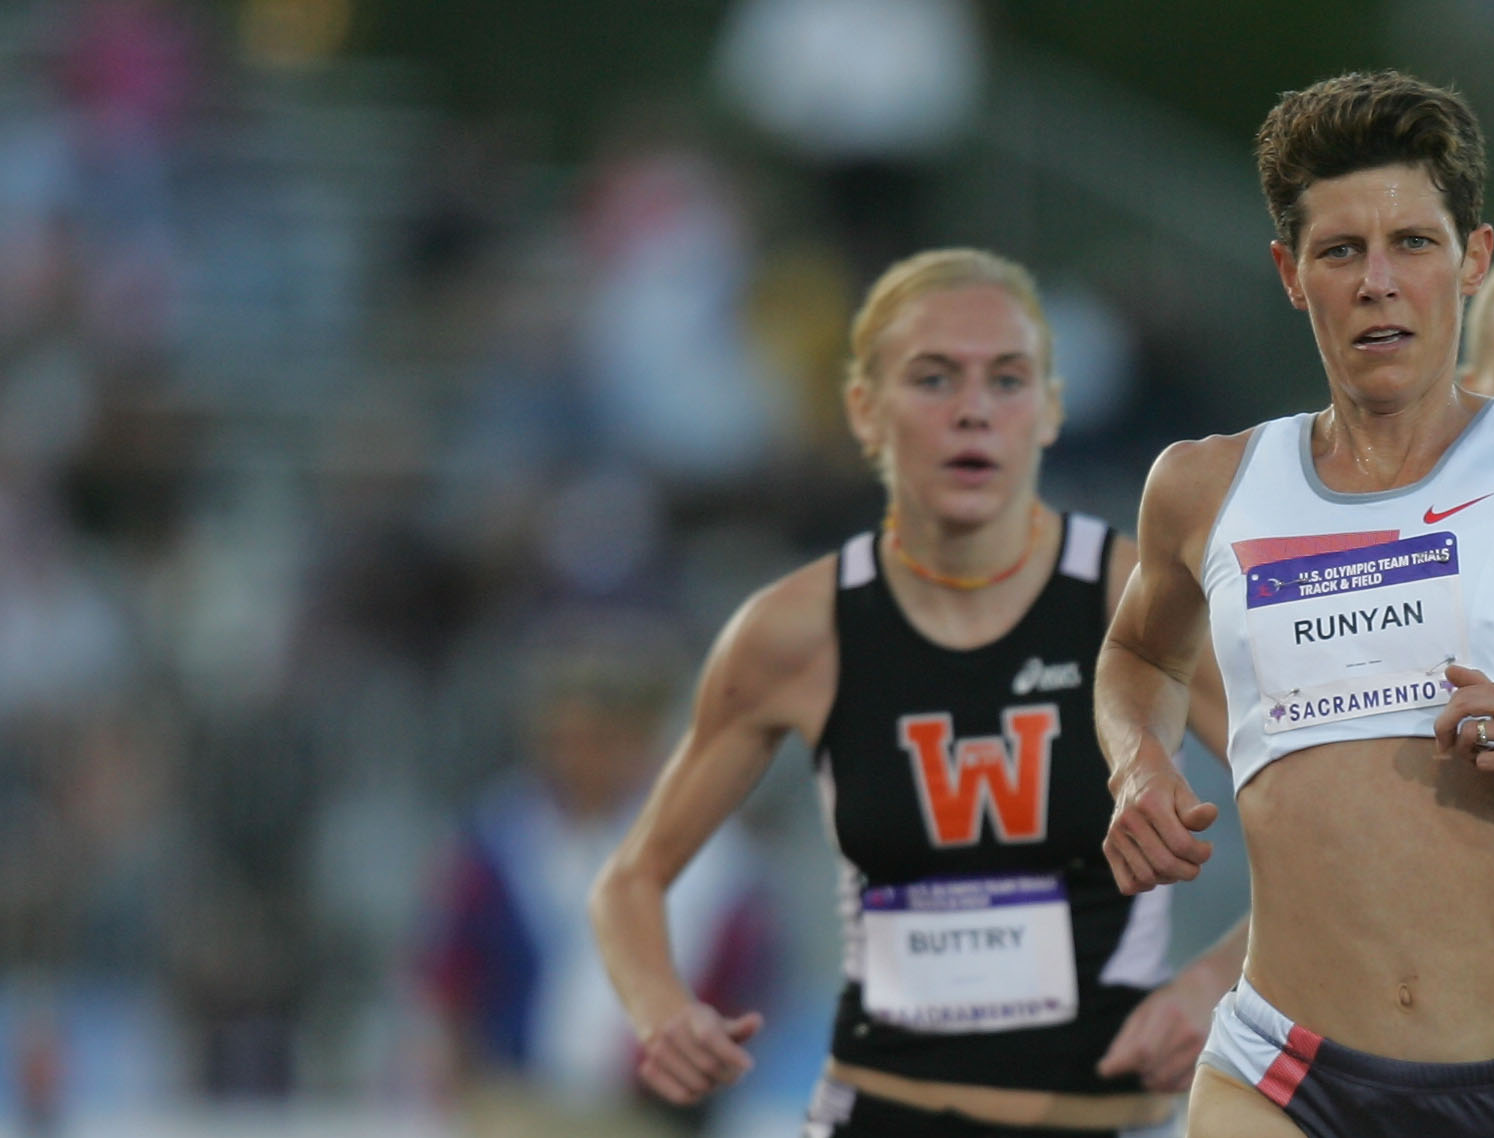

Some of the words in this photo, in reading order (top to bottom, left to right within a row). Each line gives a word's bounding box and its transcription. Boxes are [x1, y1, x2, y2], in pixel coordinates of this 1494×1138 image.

[1299, 570, 1323, 582] U.S.
[1324, 561, 1377, 580] OLYMPIC
[1377, 553, 1409, 571] TEAM
[1411, 548, 1450, 566] TRIALS
[1299, 581, 1338, 597] TRACK
[1339, 579, 1350, 590] &
[1351, 573, 1383, 588] FIELD
[1294, 600, 1424, 645] RUNYAN
[1289, 681, 1437, 722] SACRAMENTO
[898, 704, 1060, 848] W
[907, 924, 1026, 955] BUTTRY
